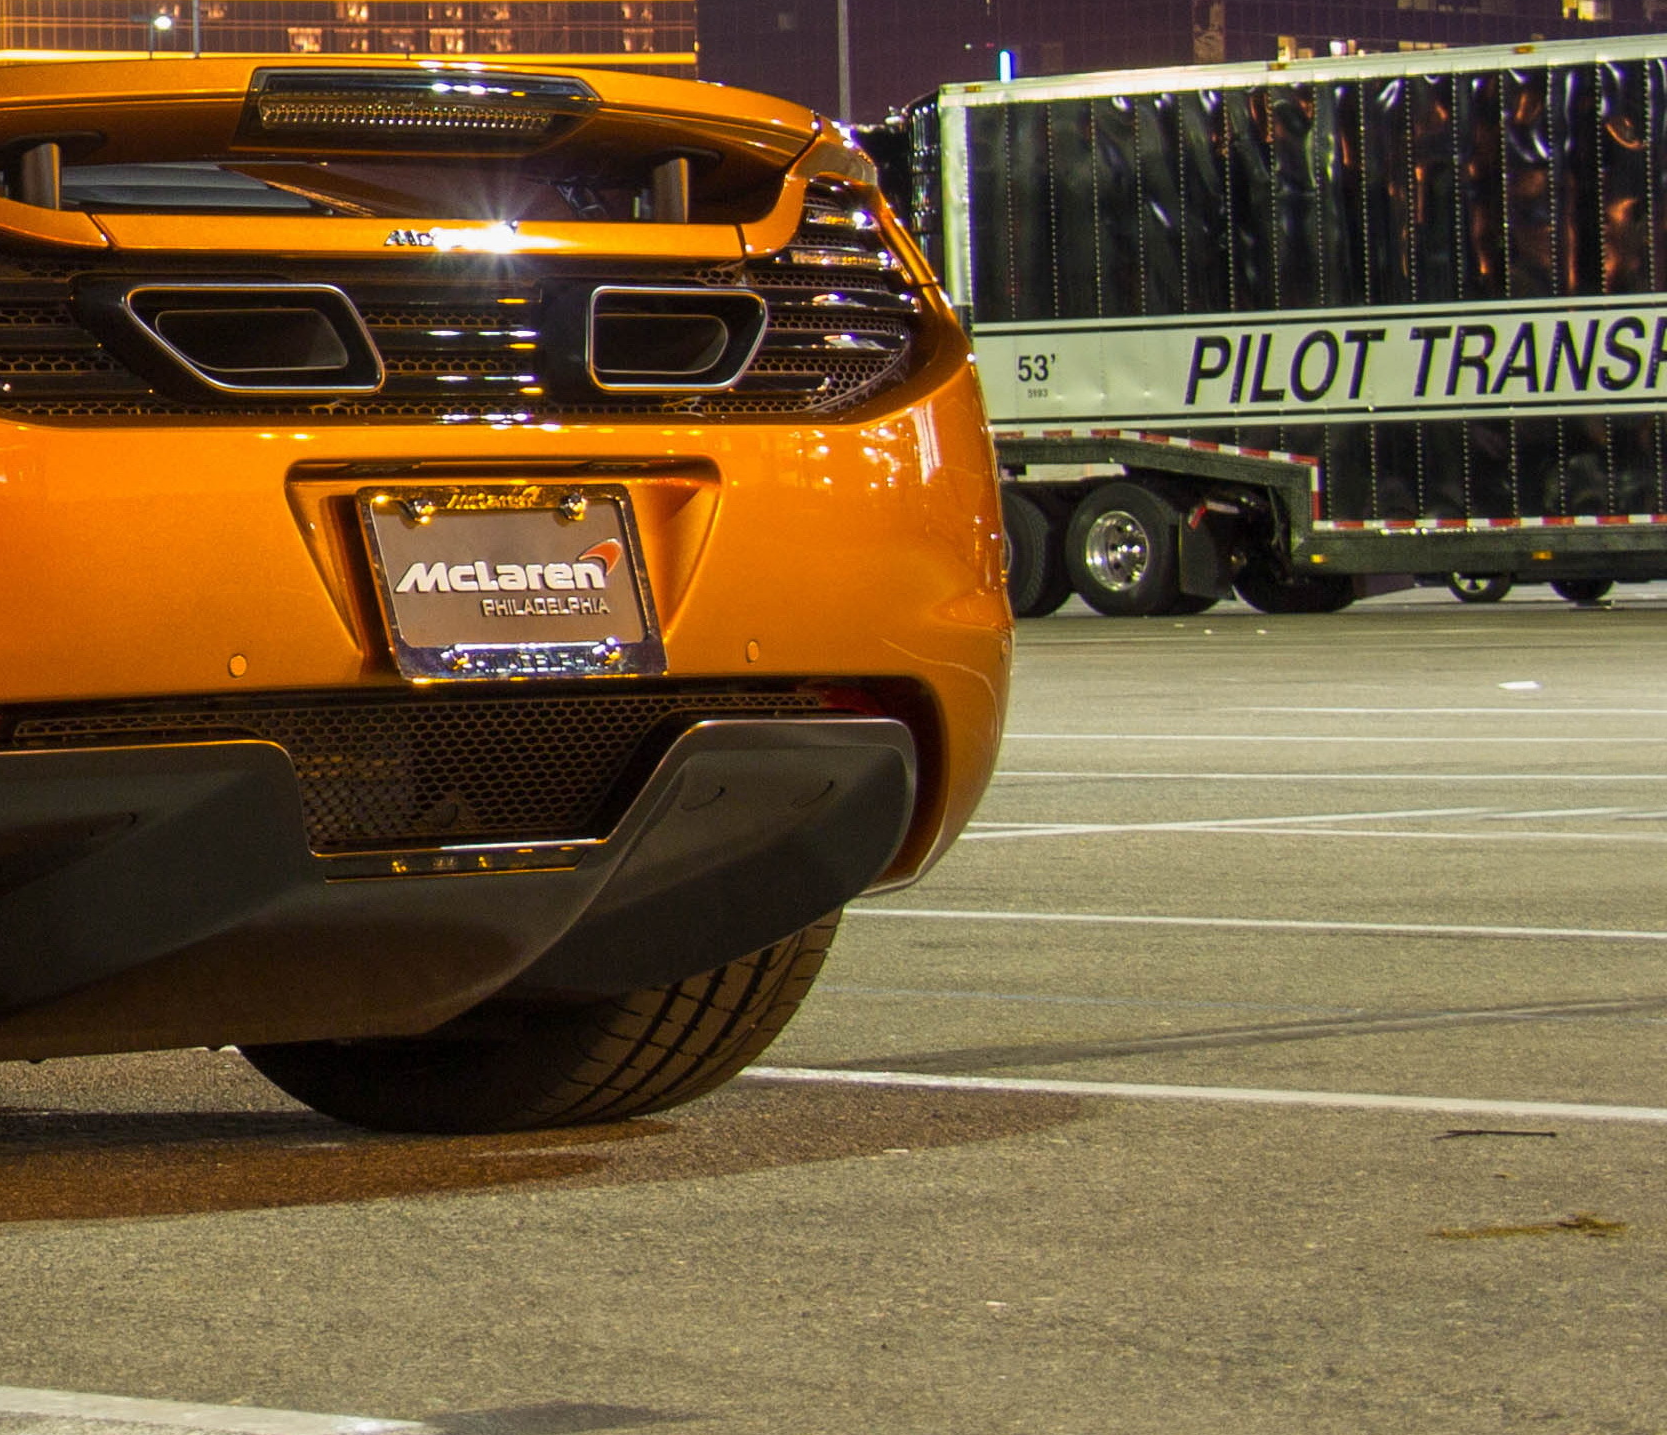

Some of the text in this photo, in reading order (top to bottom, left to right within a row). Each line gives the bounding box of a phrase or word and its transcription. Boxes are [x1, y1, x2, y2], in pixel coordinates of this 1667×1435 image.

[1018, 353, 1056, 382] 53'
[1184, 328, 1387, 406] PILOT
[395, 560, 606, 593] McLaren
[481, 596, 611, 617] PHILADELPHIA
